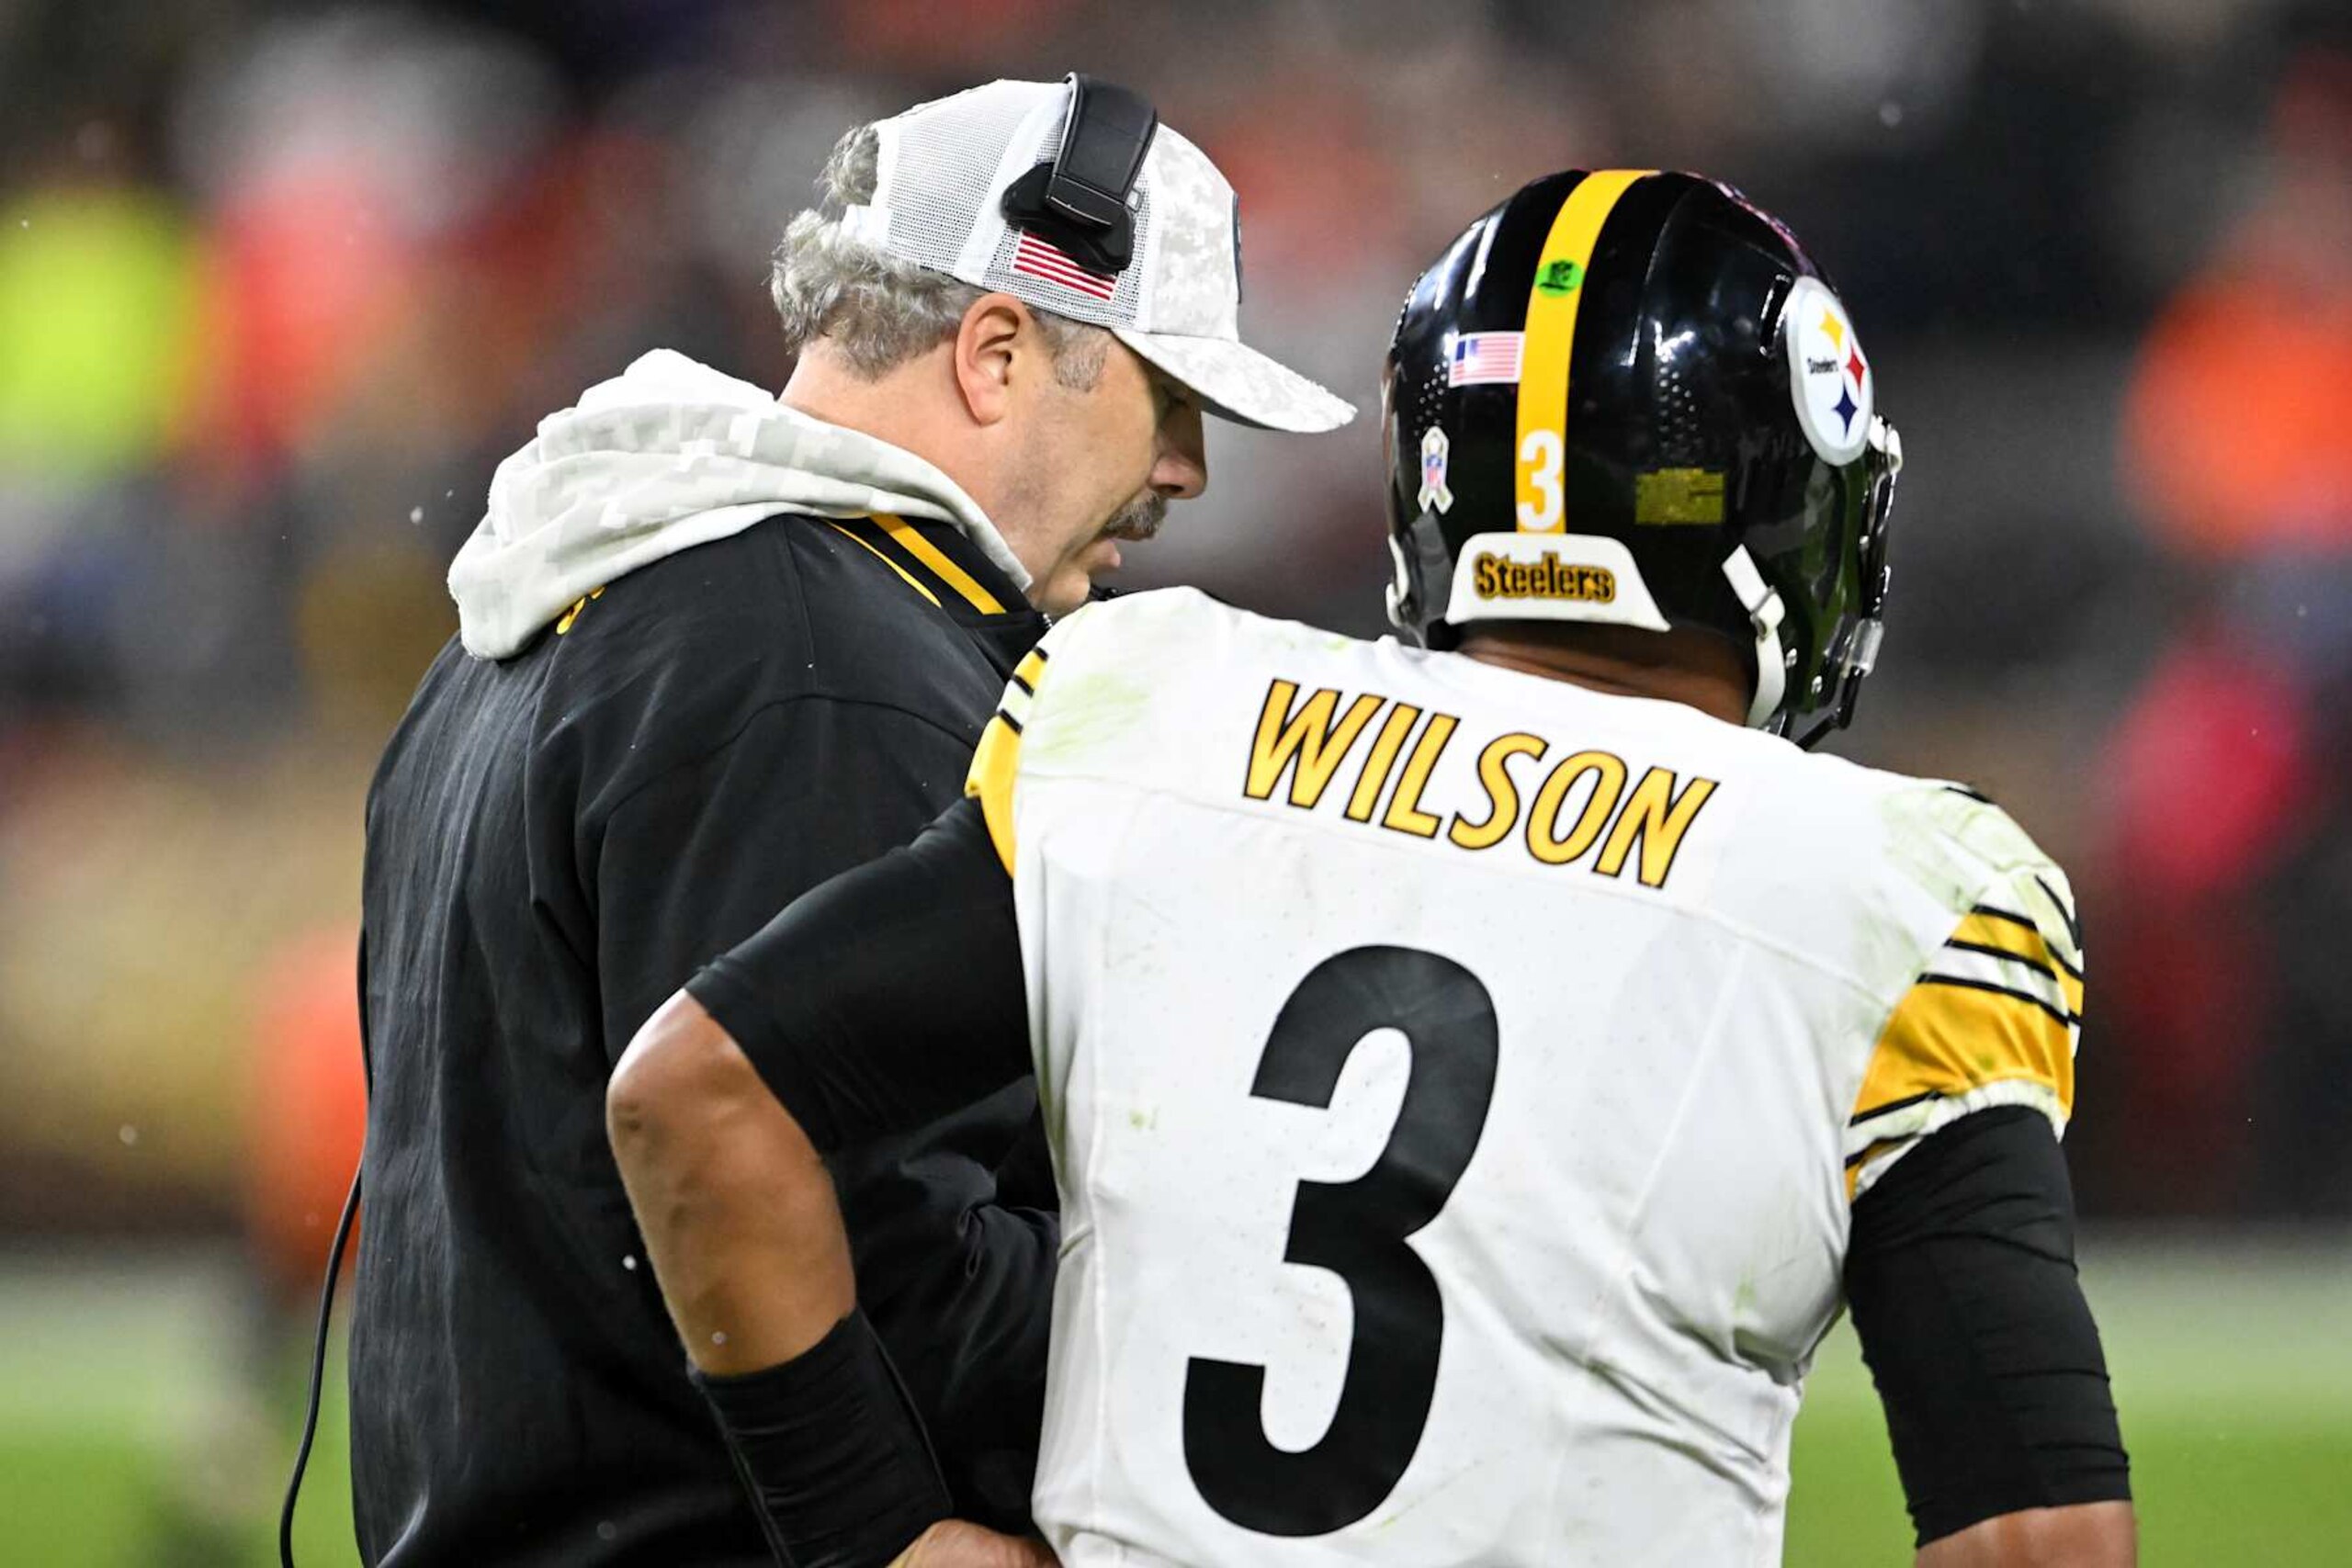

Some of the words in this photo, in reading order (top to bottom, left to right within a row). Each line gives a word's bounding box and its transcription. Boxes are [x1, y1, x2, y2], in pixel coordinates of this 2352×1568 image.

[1517, 429, 1563, 531] 3
[1474, 551, 1615, 604] Steelers
[1243, 678, 1720, 889] WILSON
[1182, 944, 1499, 1538] 3
